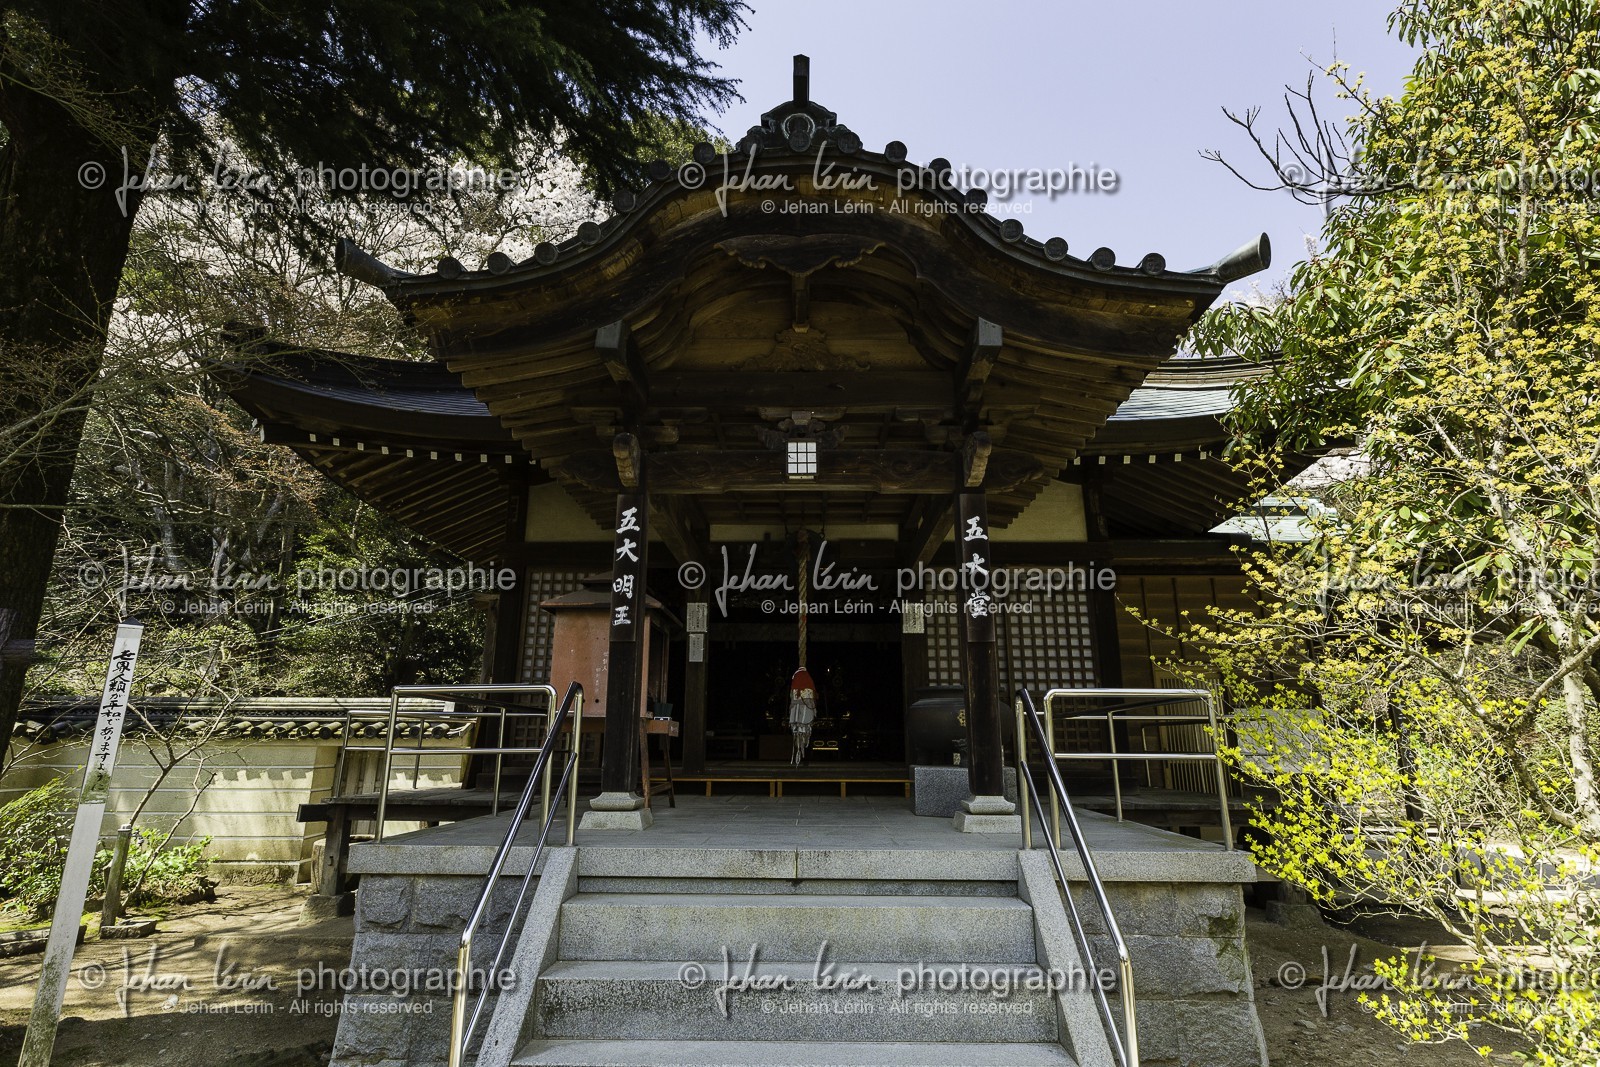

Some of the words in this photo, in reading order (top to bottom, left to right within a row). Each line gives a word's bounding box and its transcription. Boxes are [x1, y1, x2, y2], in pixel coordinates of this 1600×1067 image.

[612, 506, 640, 626] 五大明王
[963, 515, 991, 619] 五大堂
